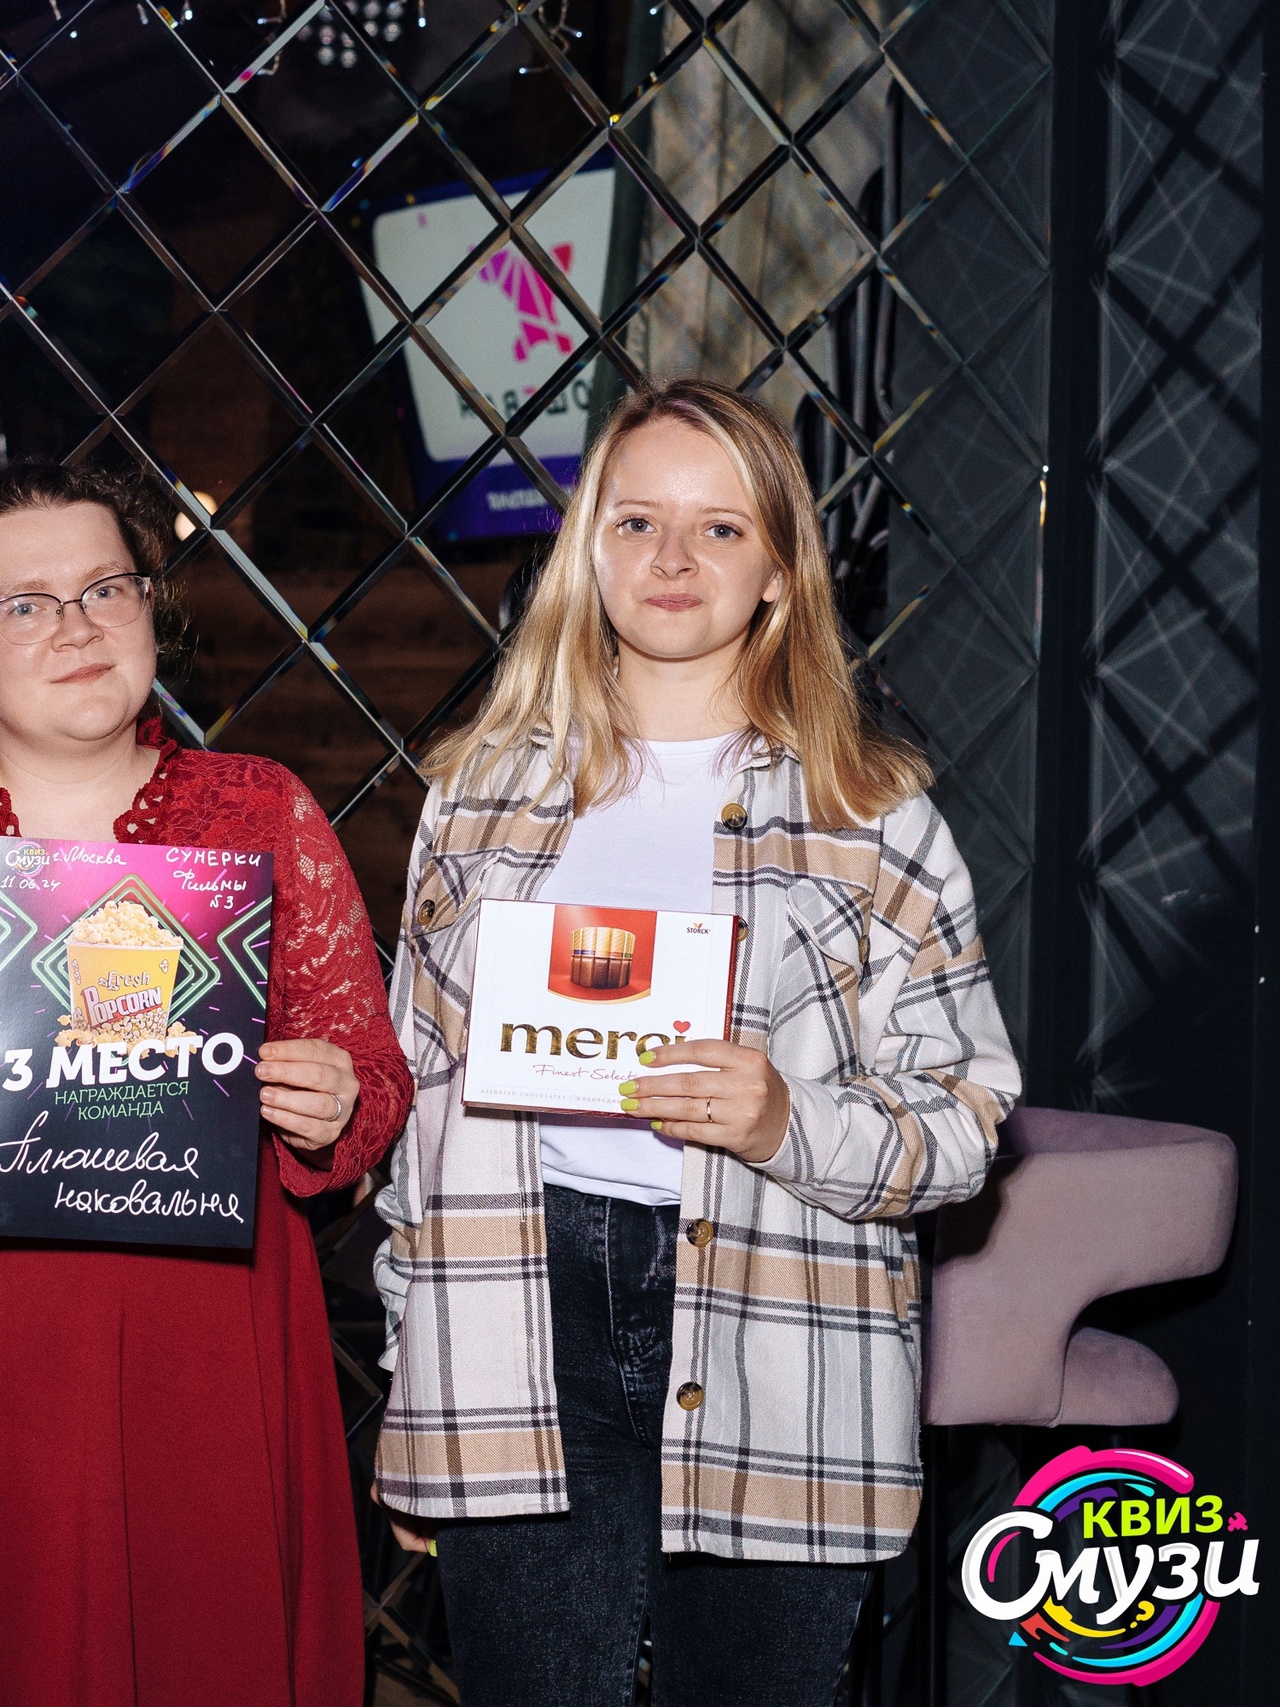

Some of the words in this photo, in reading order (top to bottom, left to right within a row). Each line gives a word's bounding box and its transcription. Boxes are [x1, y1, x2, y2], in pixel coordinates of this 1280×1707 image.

[5, 849, 51, 868] Смузи
[23, 848, 46, 856] КВИЗ
[173, 868, 247, 892] Фильмы
[686, 926, 710, 935] STORCK
[107, 970, 151, 988] Fresh
[80, 985, 163, 1029] POPCORN
[2, 1048, 34, 1092] 3
[46, 1032, 245, 1089] МЕСТО
[532, 1063, 590, 1077] Finest
[54, 1081, 190, 1106] НАГРАЖДАЕТСЯ
[480, 1089, 517, 1097] ASSORTED
[520, 1092, 566, 1100] CHOCOLATES
[77, 1101, 165, 1121] КОМАНДА
